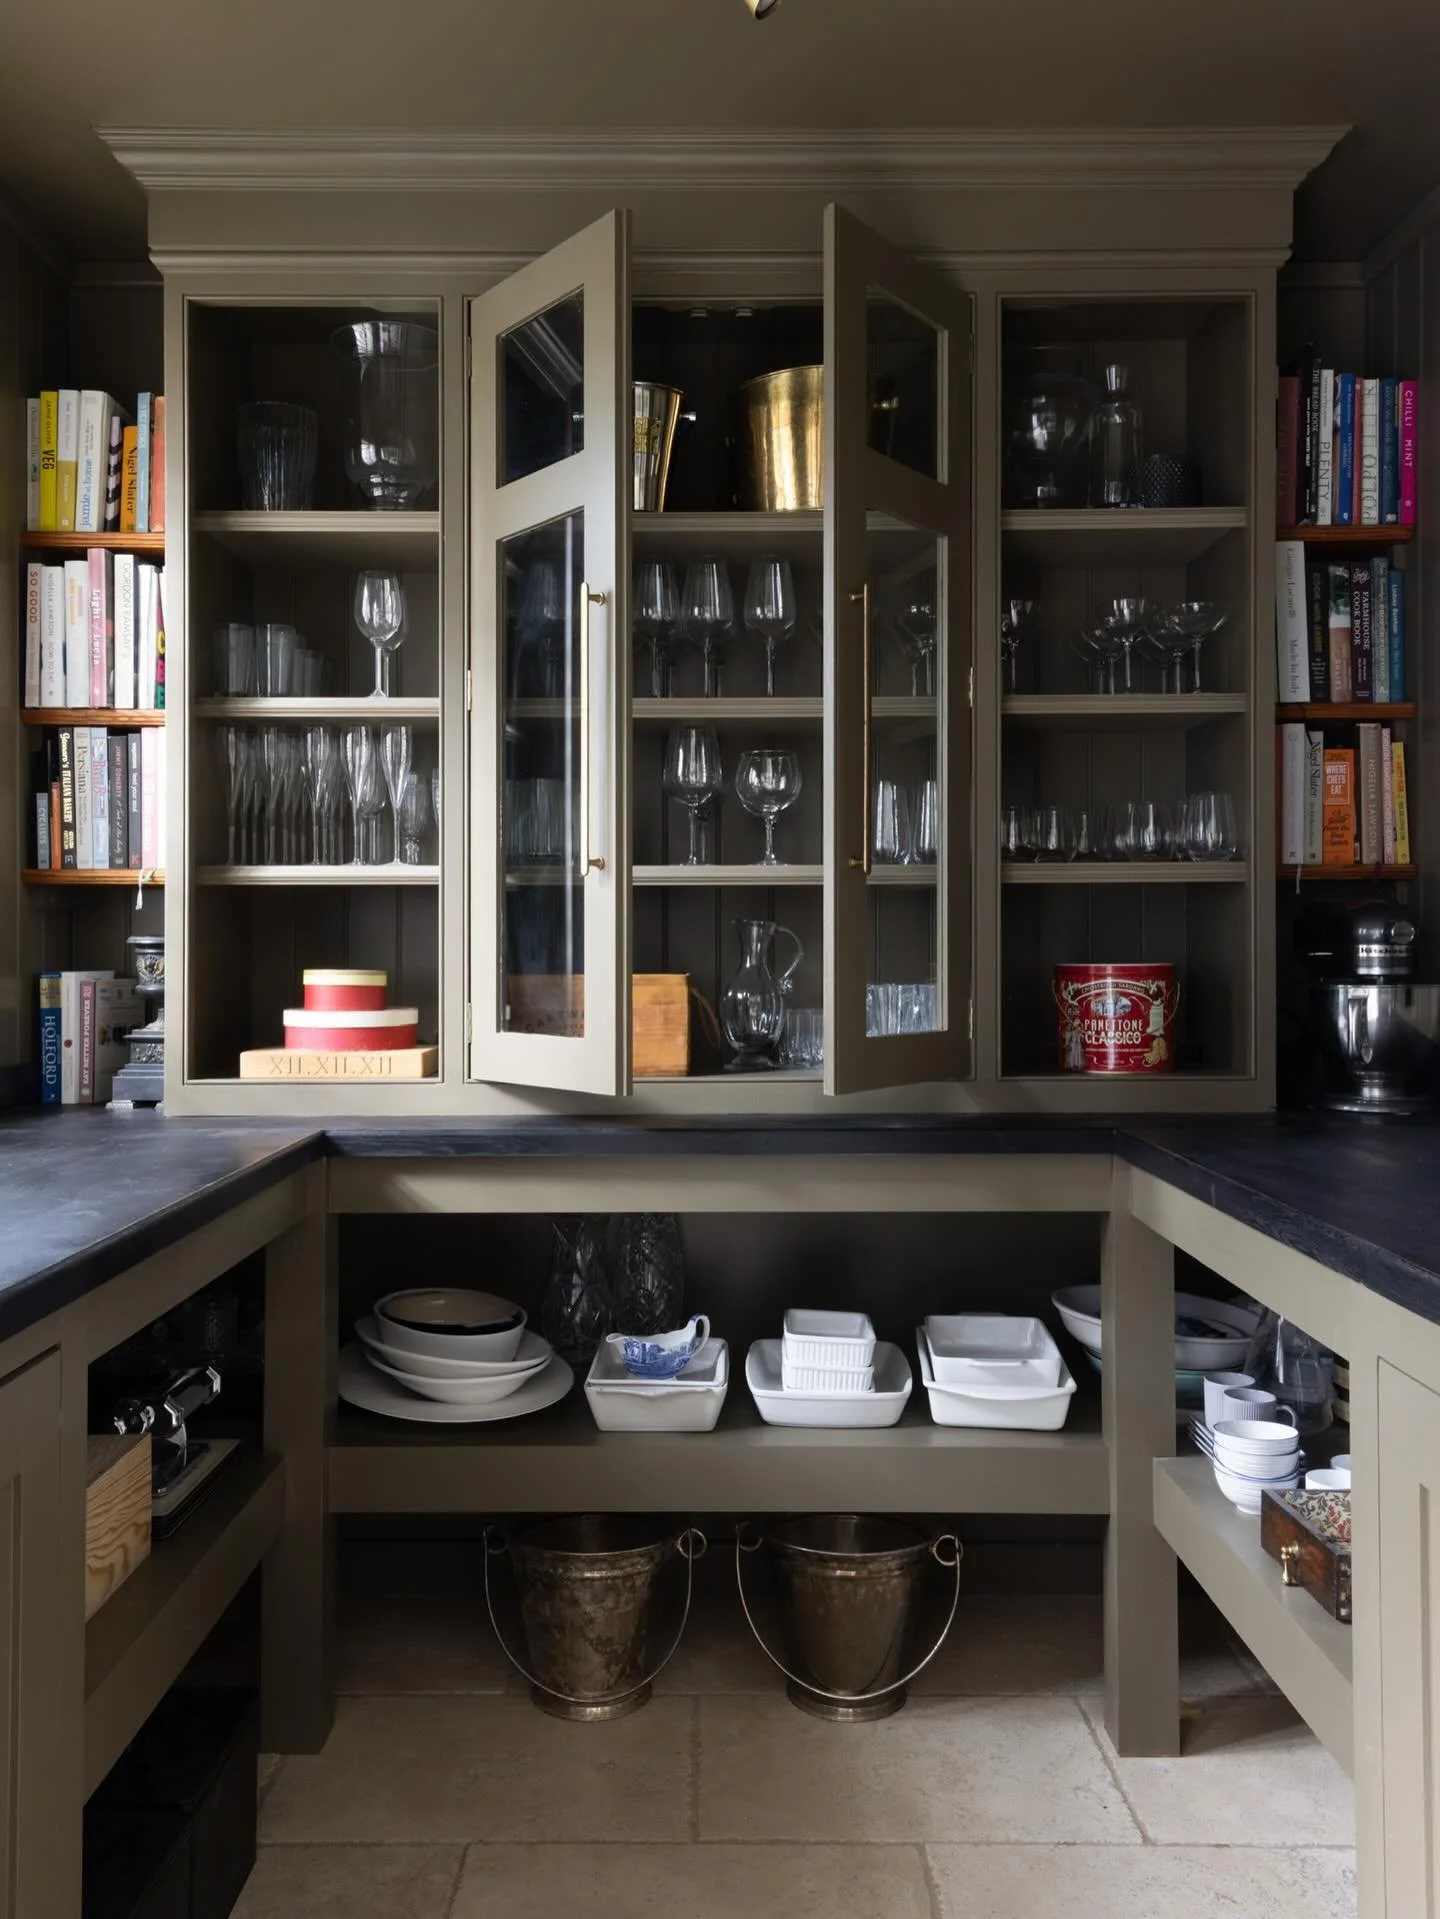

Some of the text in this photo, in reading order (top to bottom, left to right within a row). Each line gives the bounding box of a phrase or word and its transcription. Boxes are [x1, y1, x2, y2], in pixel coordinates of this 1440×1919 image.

[1405, 390, 1413, 467] CHILLI MINT
[42, 449, 55, 470] VEG
[83, 458, 92, 485] home
[1318, 441, 1331, 500] PLENTY
[127, 447, 138, 514] Nigel Slater
[80, 494, 91, 528] jamie
[30, 570, 38, 586] SO
[123, 562, 131, 608] GORDON
[29, 590, 38, 624] GOOD
[91, 588, 101, 620] Light
[1353, 591, 1361, 617] COOK
[1307, 741, 1320, 767] Nigel
[76, 745, 88, 795] Persiana
[1326, 764, 1348, 774] WHERE
[1326, 775, 1346, 784] CHEFS
[62, 770, 72, 797] ITALIAN
[1310, 769, 1320, 799] Slater
[1330, 785, 1342, 795] EAT
[63, 798, 72, 823] BAKERY
[1368, 759, 1377, 847] NIGELLA LAWSON
[38, 807, 46, 845] CYCLISTS
[1084, 1019, 1144, 1032] PANETTONE
[1084, 1031, 1142, 1046] CLASSICO
[45, 1015, 57, 1085] HOLFORD
[83, 1037, 91, 1068] BETTER
[269, 1056, 392, 1075] XII.XII.XII
